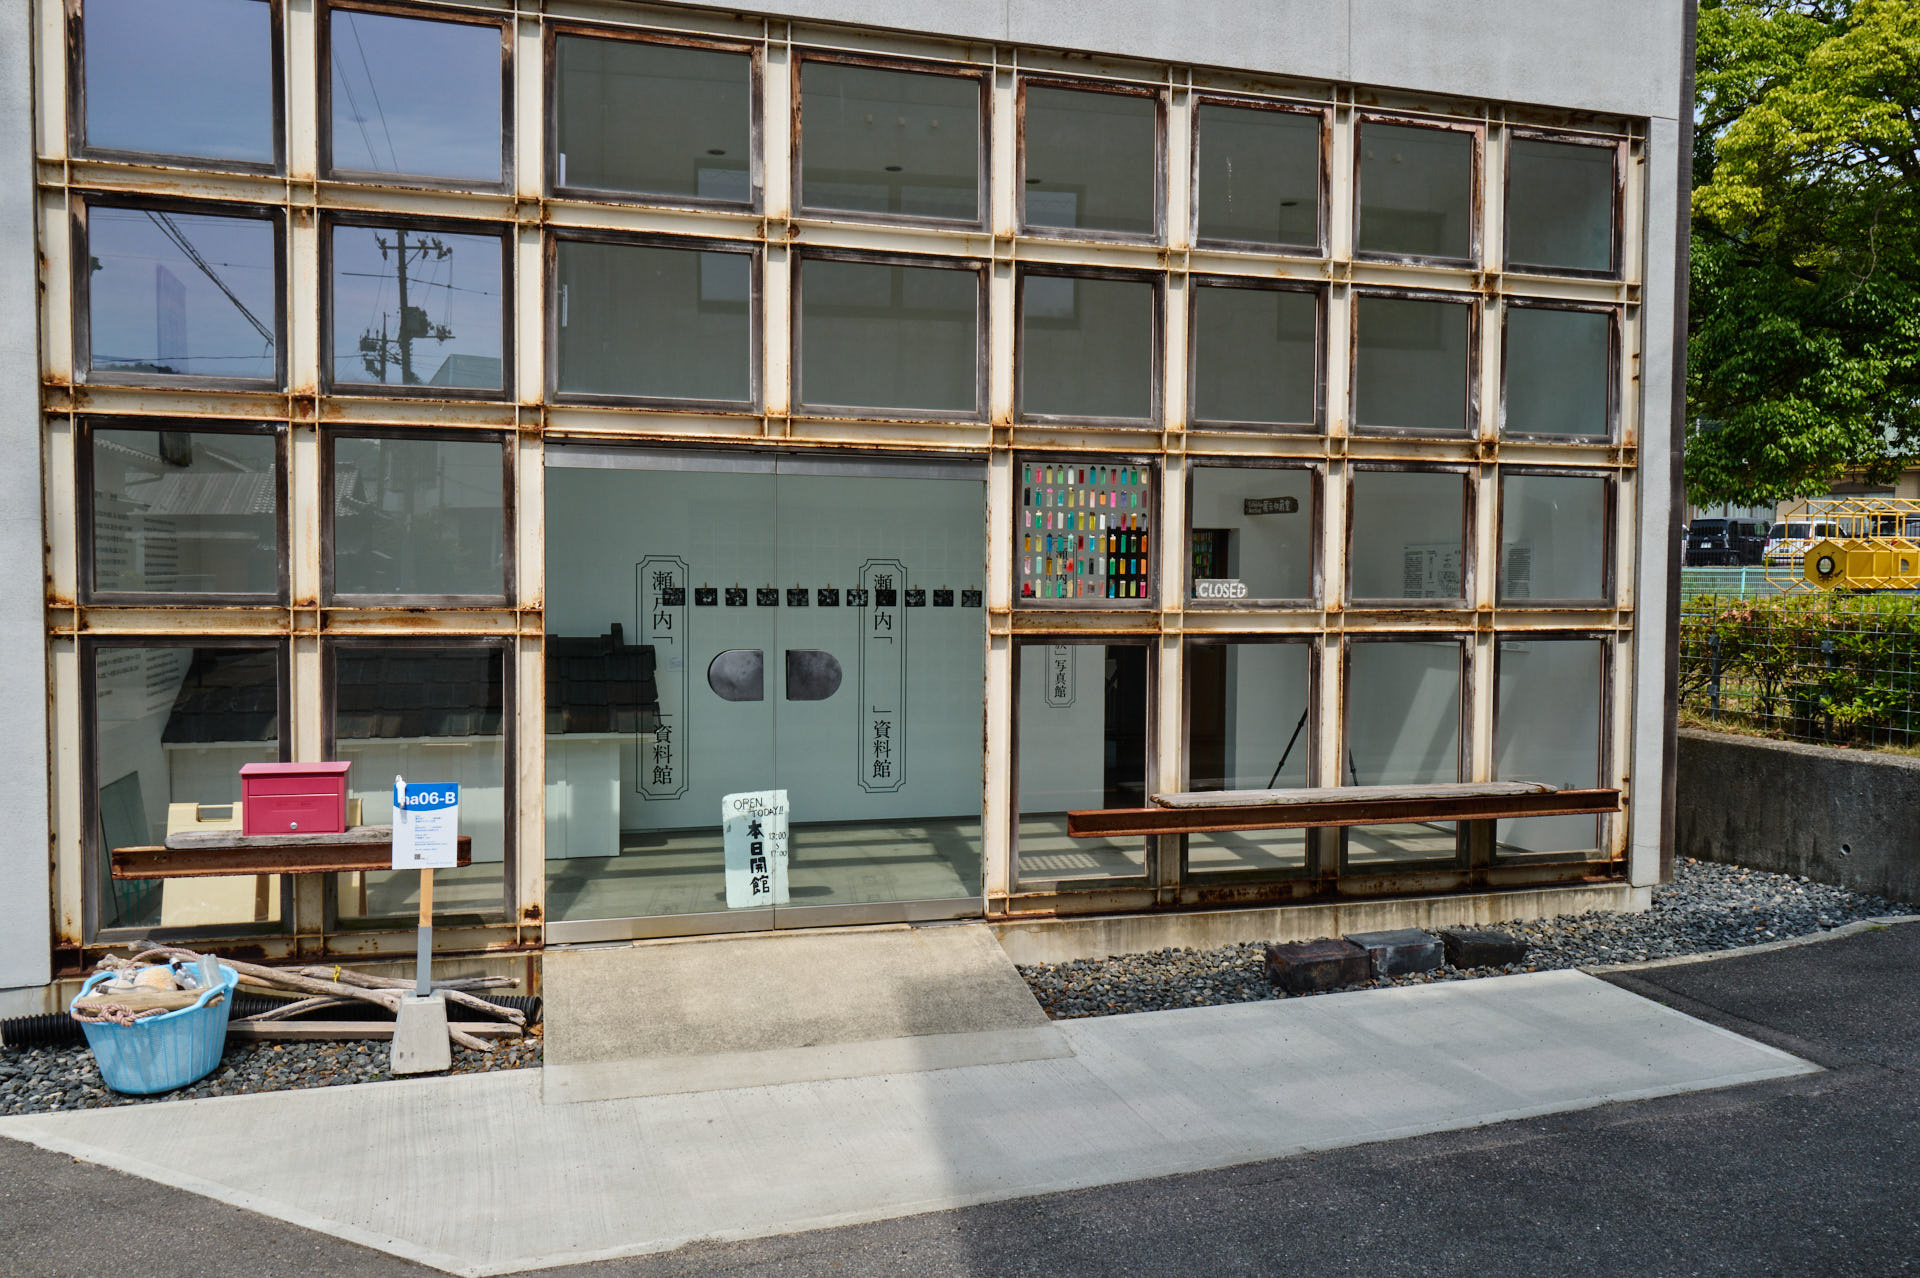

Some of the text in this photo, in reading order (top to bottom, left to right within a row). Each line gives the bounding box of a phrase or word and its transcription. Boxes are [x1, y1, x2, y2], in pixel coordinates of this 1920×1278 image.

[1198, 582, 1247, 598] CLOSED
[733, 797, 763, 810] OPEN
[750, 805, 784, 817] TODAY!!
[746, 819, 770, 896] 本日開館
